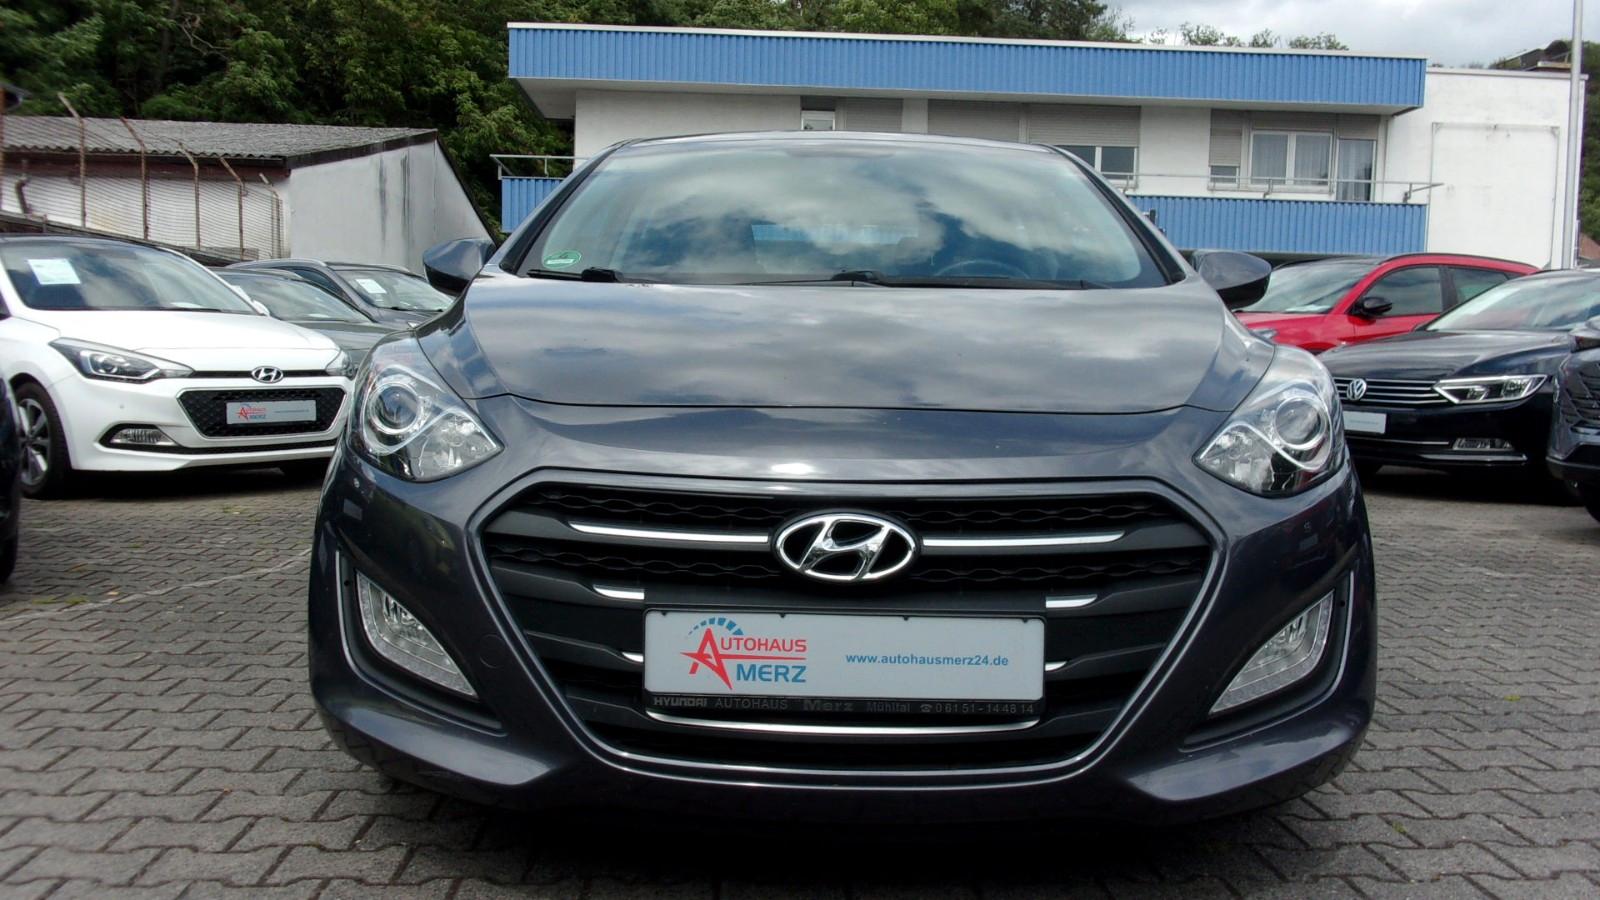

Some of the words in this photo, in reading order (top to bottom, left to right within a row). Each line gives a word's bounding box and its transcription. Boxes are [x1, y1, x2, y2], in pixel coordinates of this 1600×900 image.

[846, 653, 1009, 666] www.autohausmerz24.de
[736, 664, 807, 683] MERZ
[715, 698, 788, 710] AUTOHAUS
[803, 700, 853, 711] Merz
